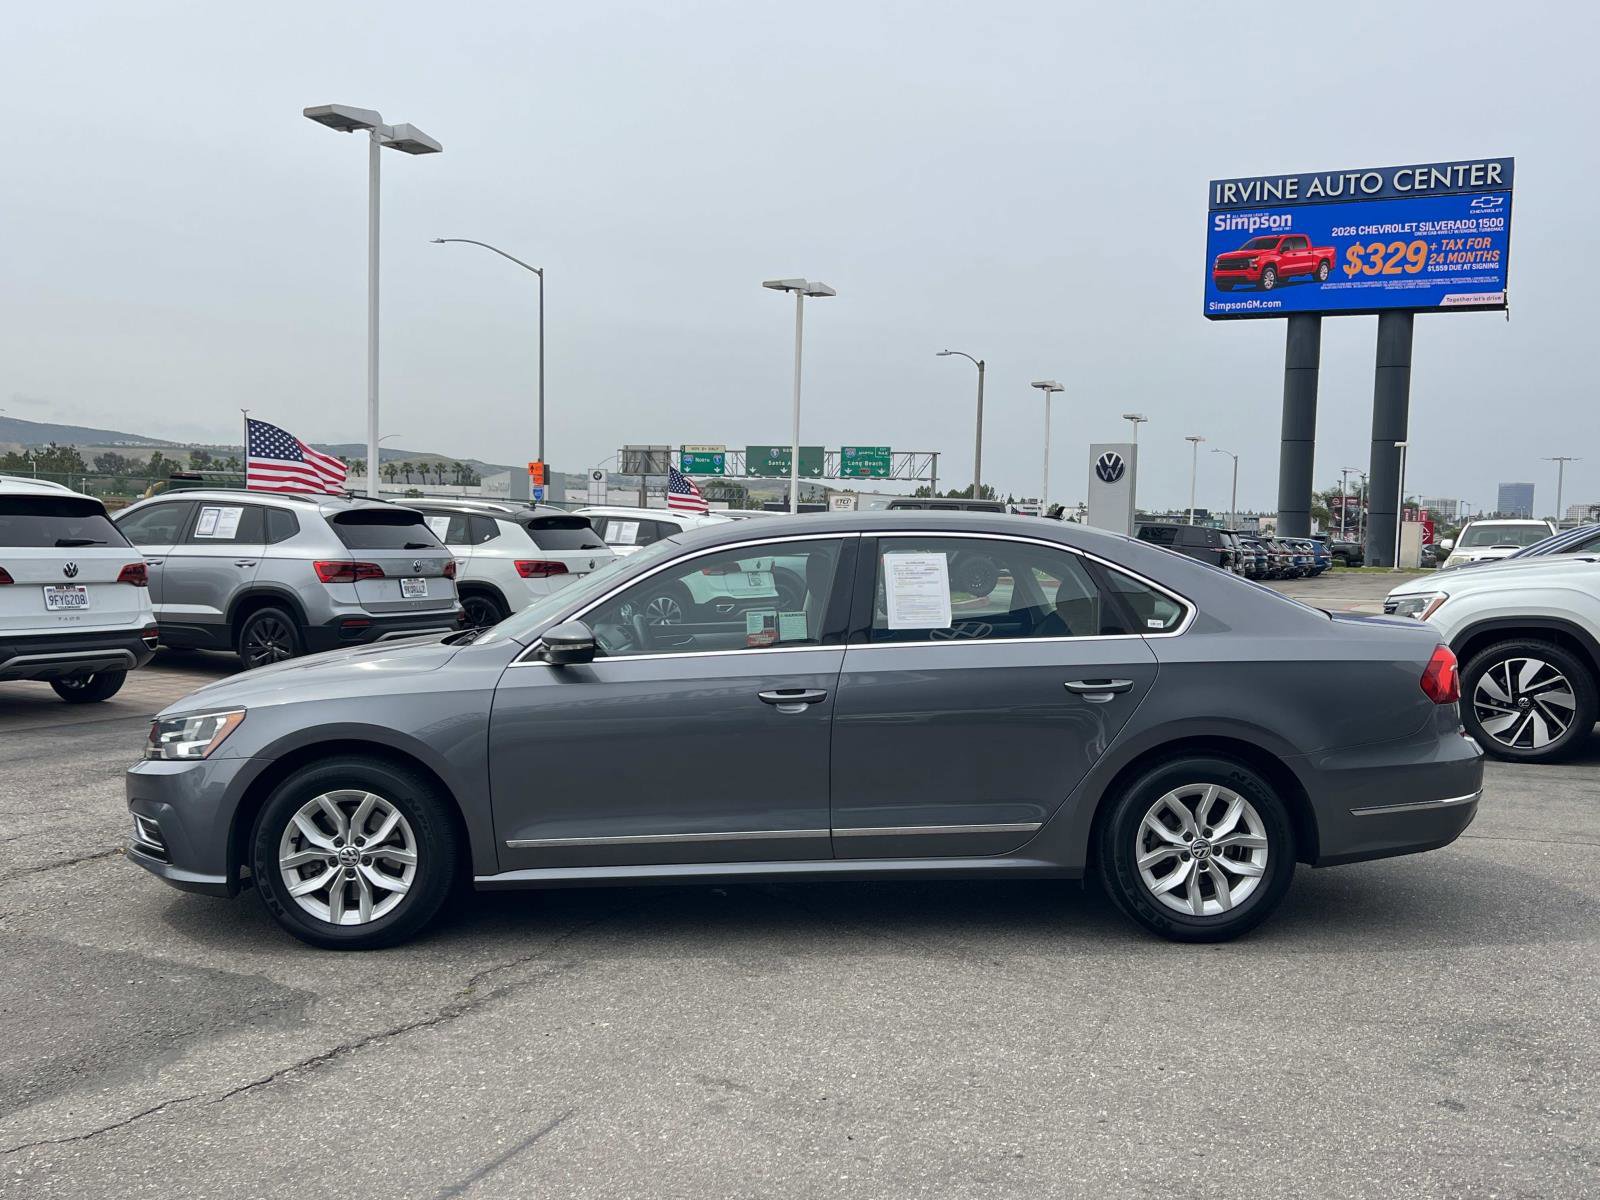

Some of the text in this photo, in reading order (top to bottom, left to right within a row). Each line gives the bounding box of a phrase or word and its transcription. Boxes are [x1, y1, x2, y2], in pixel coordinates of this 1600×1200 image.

[1216, 163, 1503, 204] IRVINE AUTO CENTER
[1214, 213, 1292, 233] Simpson
[1331, 217, 1504, 237] 2026 CHEVROLET SILVERADO 1500
[1441, 239, 1465, 251] TAX
[1466, 237, 1492, 250] FOR
[1342, 240, 1428, 279] $329
[1429, 250, 1500, 265] 24 MONTHS
[1472, 262, 1499, 270] SIGNING
[1209, 300, 1282, 312] SimpsonGM.com
[847, 460, 863, 468] Long
